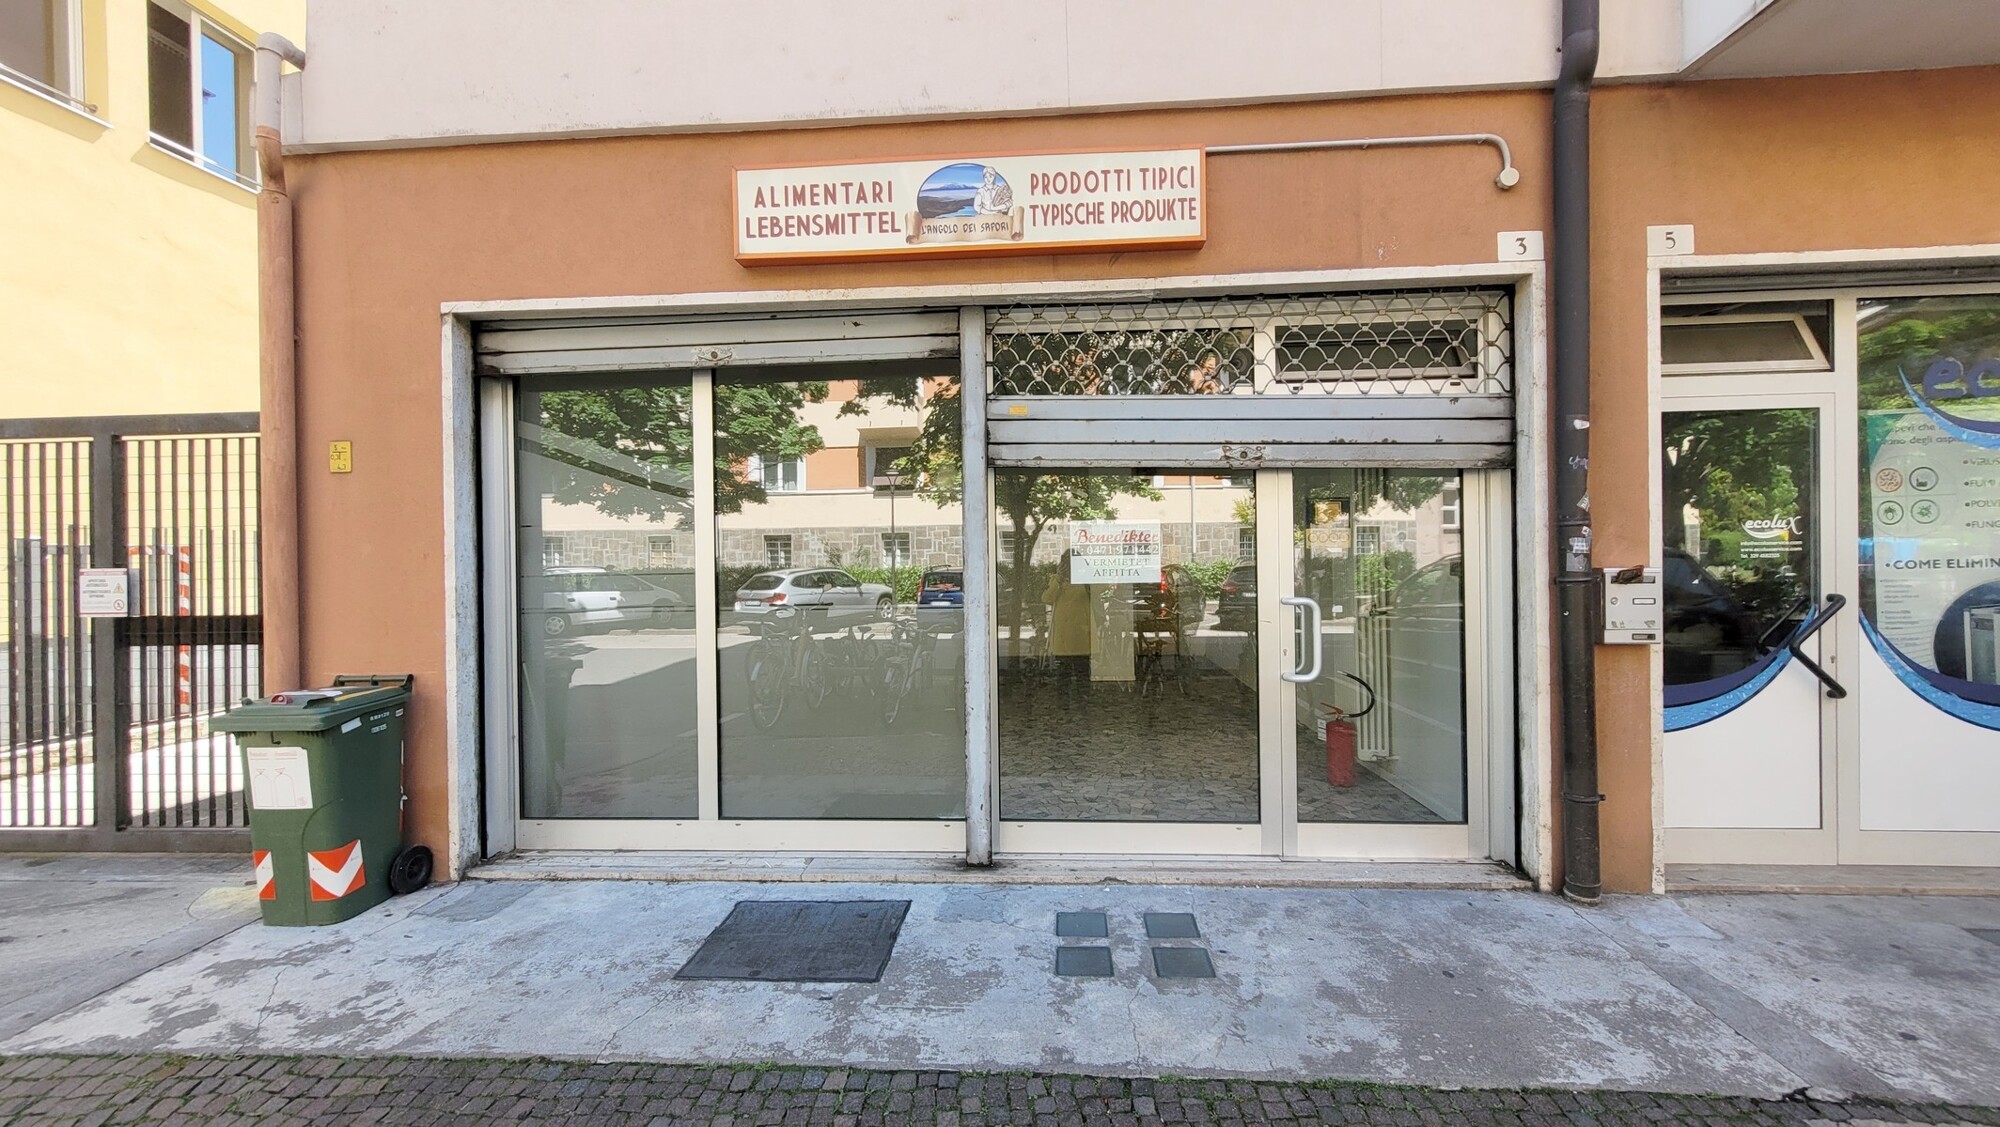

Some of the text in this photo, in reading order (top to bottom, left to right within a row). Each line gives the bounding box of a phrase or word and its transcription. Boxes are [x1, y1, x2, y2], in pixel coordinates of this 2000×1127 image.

[1030, 165, 1195, 196] PRODOTTI TIPICI
[754, 180, 893, 208] ALIMENTARI
[1029, 197, 1197, 227] TYPISCHE PRODUKTE
[745, 211, 902, 239] LEBENSMITTEL
[921, 223, 959, 235] L'ANGOLO
[962, 222, 977, 233] DEI
[1514, 237, 1527, 255] 3
[1664, 231, 1676, 249] 5
[1909, 436, 1933, 446] degli
[1083, 558, 1151, 567] VERMIETET
[1892, 559, 1942, 570] COME
[1093, 568, 1141, 577] AFFITTA
